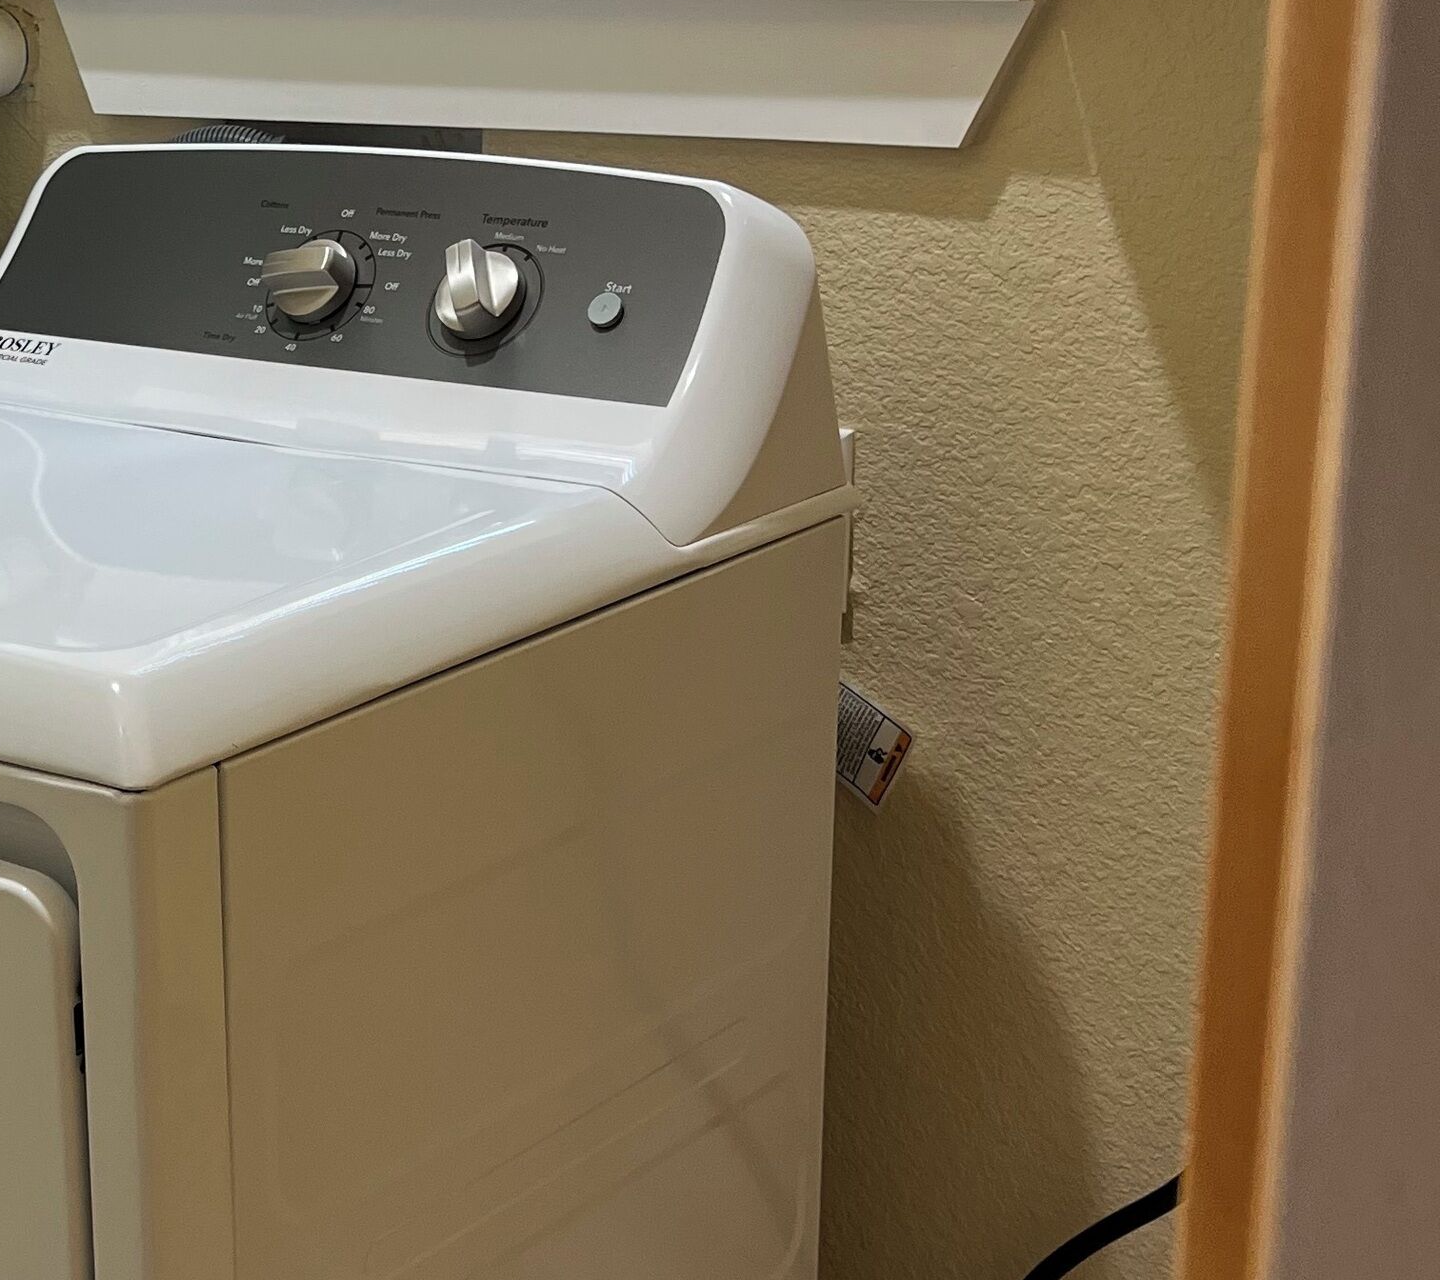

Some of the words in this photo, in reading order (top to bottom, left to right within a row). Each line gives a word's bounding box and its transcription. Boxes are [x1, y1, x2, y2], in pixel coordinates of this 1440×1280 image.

[341, 208, 356, 218] Off
[482, 213, 549, 229] Temperature
[280, 224, 297, 234] Less
[298, 225, 312, 237] Dry
[369, 231, 391, 241] More
[391, 233, 408, 244] Dry
[494, 231, 525, 241] Medium
[377, 248, 396, 258] Less
[396, 249, 413, 261] Dry
[384, 282, 400, 291] Off
[604, 281, 633, 295] Start
[252, 304, 263, 313] 10
[363, 305, 376, 314] 80
[254, 325, 266, 335] 20
[330, 334, 343, 343] 60
[284, 343, 297, 352] 40
[19, 356, 48, 366] GRADE
